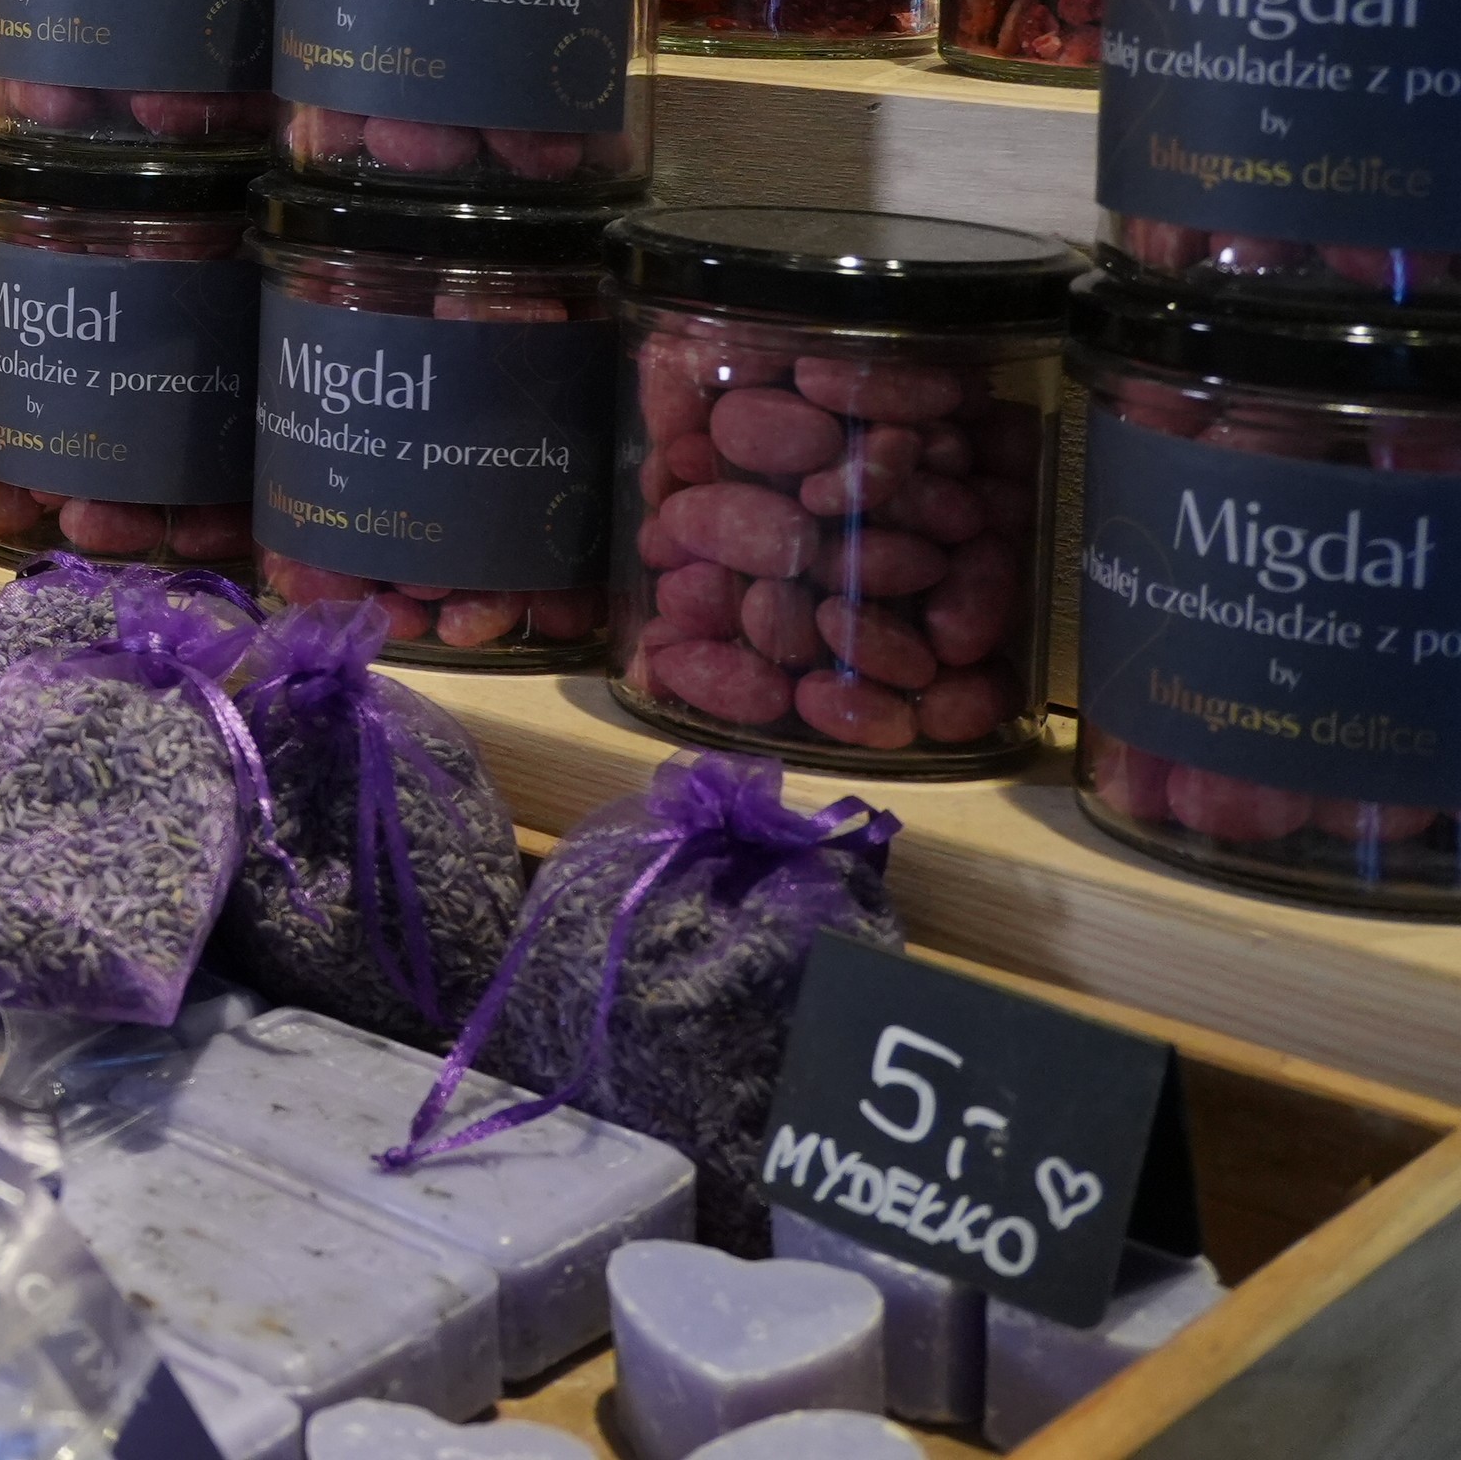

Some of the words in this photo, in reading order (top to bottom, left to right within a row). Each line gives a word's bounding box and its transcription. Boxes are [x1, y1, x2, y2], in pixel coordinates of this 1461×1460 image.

[37, 16, 111, 46] délice
[336, 6, 356, 31] by
[281, 34, 354, 71] blugrass
[361, 44, 447, 81] délice
[1145, 41, 1354, 92] czekoladzie
[1366, 65, 1390, 93] z
[1260, 108, 1292, 139] by
[1149, 139, 1291, 189] blugrass
[1302, 156, 1433, 199] délice
[87, 367, 100, 388] z
[109, 366, 241, 399] porzeczką
[279, 336, 438, 414] Migdał
[26, 395, 44, 419] by
[49, 431, 128, 464] délice
[268, 411, 386, 457] czekoladzie
[397, 439, 413, 462] z
[423, 437, 571, 473] porzeczką
[328, 466, 349, 492] by
[267, 481, 348, 528] blugrass
[354, 510, 444, 542] délice
[1174, 488, 1436, 594] Migdał
[1146, 584, 1362, 649] czekoladzie
[1376, 626, 1399, 653] z
[1269, 655, 1302, 690] by
[763, 1124, 1038, 1278] MYDEŁKO
